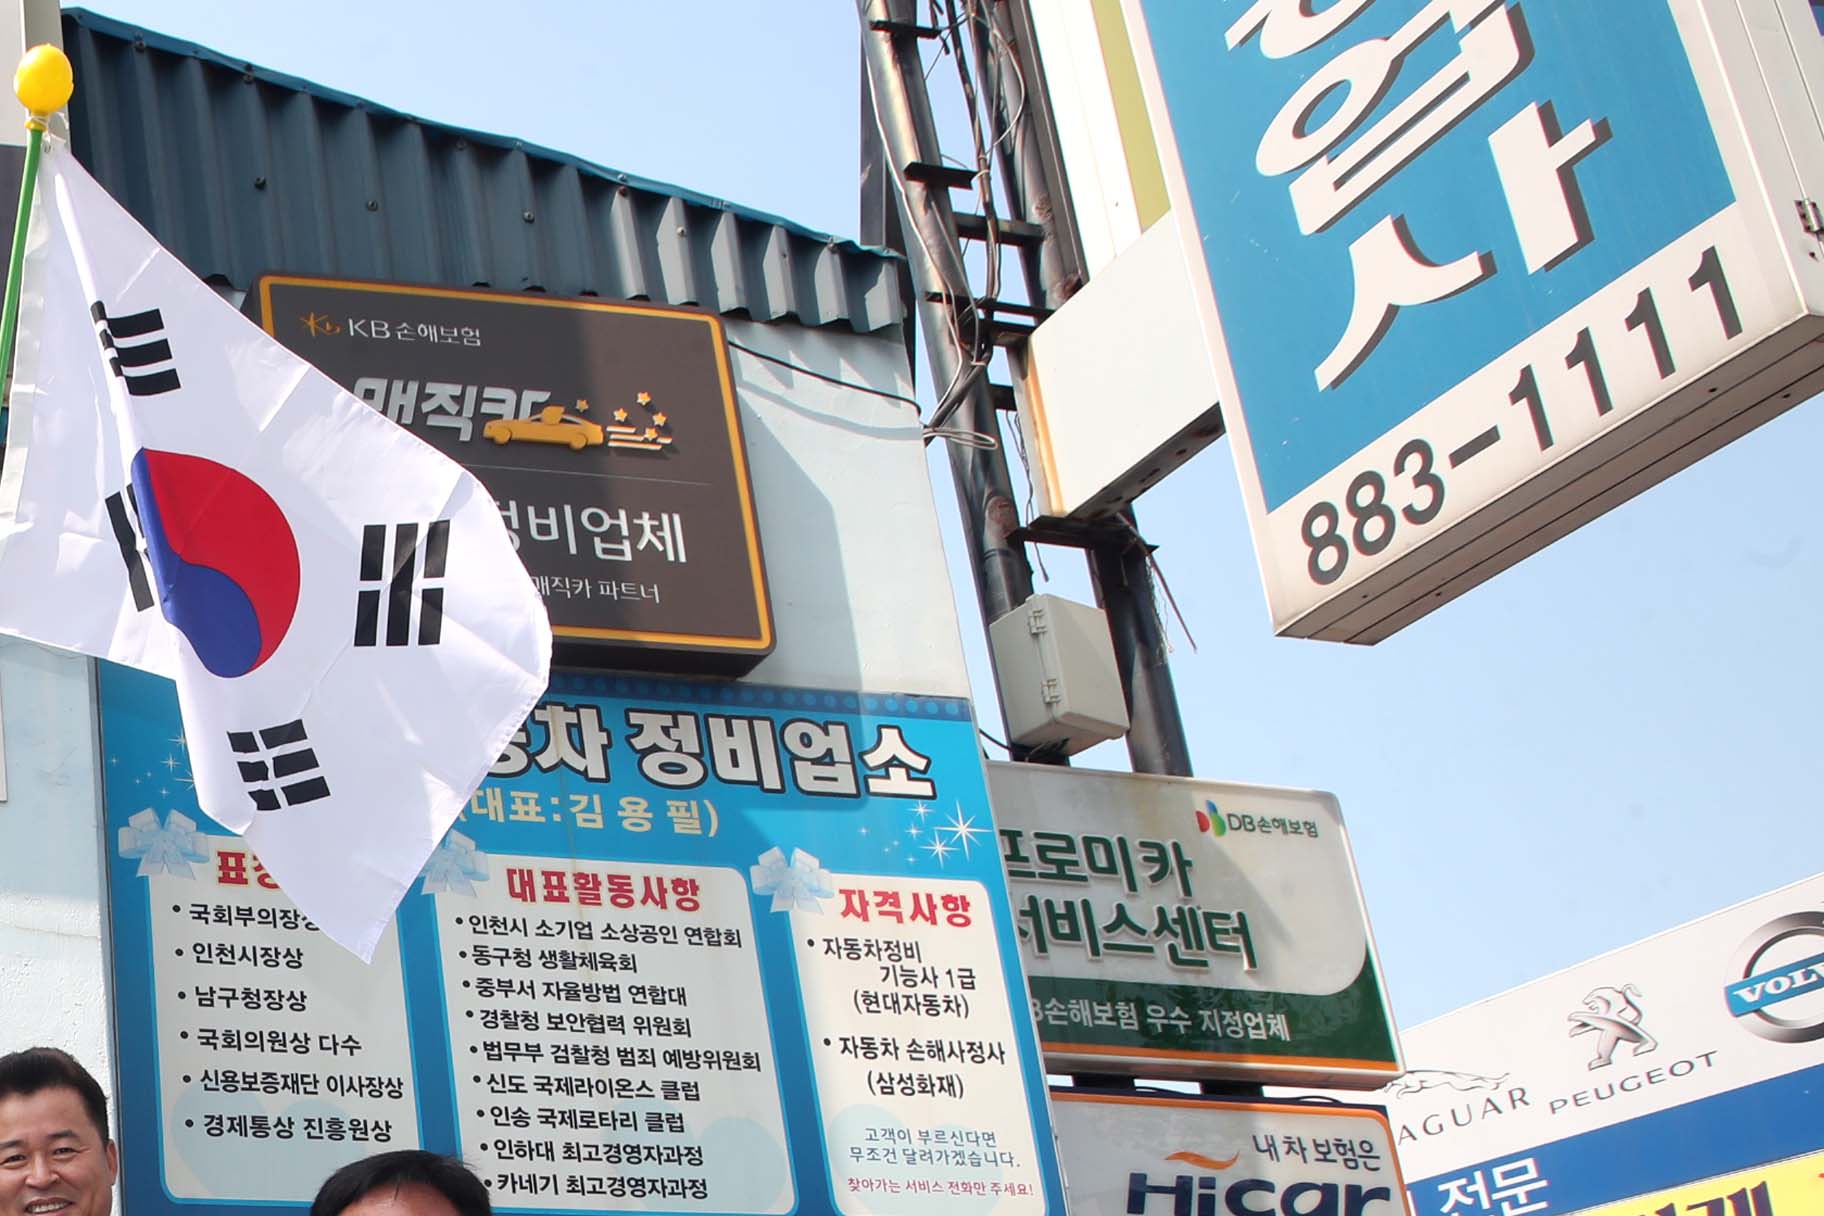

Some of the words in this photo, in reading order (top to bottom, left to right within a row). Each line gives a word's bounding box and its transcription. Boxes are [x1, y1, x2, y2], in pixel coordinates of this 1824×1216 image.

[1301, 245, 1744, 585] 883-1111
[598, 580, 660, 604] 파트너
[624, 708, 937, 800] 정비업소
[617, 796, 654, 833] 용
[667, 799, 719, 838] 필)
[998, 828, 1194, 898] 프로미카
[506, 868, 701, 912] 대표활동사항
[839, 889, 972, 928] 자격사항
[469, 914, 528, 937] 인천시
[535, 919, 593, 940] 소기업
[601, 923, 678, 944] 소상공인
[684, 926, 742, 948] 연합회
[1018, 894, 1258, 971] 서비스센터
[192, 942, 303, 969] 인천시장상
[472, 945, 531, 967] 동구청
[539, 950, 638, 973] 생활체육회
[823, 937, 922, 964] 자동차정비
[475, 977, 536, 999] 중부서
[628, 985, 687, 1007] 연합대
[880, 965, 938, 989] 기능사
[945, 968, 976, 990] 1급
[195, 986, 307, 1012] 남구청장상
[853, 990, 970, 1019] (현대자동차)
[479, 1008, 539, 1031] 경찰청
[546, 1012, 625, 1034] 보안협력
[633, 1016, 691, 1038] 위원회
[1146, 1004, 1192, 1034] 우수
[1199, 1009, 1291, 1041] 지정업체
[197, 1028, 310, 1054] 국회의원상
[319, 1034, 362, 1056] 다수
[482, 1041, 543, 1063] 법무부
[550, 1044, 610, 1066] 검찰청
[616, 1047, 656, 1068] 범죄
[663, 1049, 762, 1072] 예방위원회
[839, 1036, 899, 1061] 자동차
[906, 1038, 1005, 1065] 손해사정사
[200, 1069, 320, 1095] 신용보증재단
[326, 1075, 403, 1099] 이사장상
[487, 1073, 527, 1095] 신도
[533, 1075, 655, 1100] 국제라이온스
[660, 1080, 701, 1101] 클럽
[867, 1070, 964, 1099] (삼성화재)
[1548, 1050, 1718, 1115] PEUGEOT
[204, 1114, 294, 1139] 경제통상
[304, 1117, 392, 1143] 진흥원상
[490, 1105, 530, 1128] 인송
[537, 1108, 638, 1131] 국제로타리
[644, 1111, 685, 1134] 클럽
[865, 1127, 912, 1145] 고객이
[918, 1130, 996, 1148] 부르신다면
[494, 1139, 555, 1162] 인하대
[562, 1142, 704, 1166] 최고경영자과정
[849, 1147, 897, 1164] 무조건
[902, 1149, 1021, 1168] 달려가겠습니다.
[1312, 1138, 1380, 1171] 보험은
[497, 1172, 559, 1195] 카네기
[566, 1175, 708, 1200] 최고경영자과정
[848, 1177, 901, 1194] 찾아가는
[905, 1179, 945, 1194] 서비스
[948, 1180, 986, 1196] 전화만
[990, 1182, 1034, 1197] 주세요!
